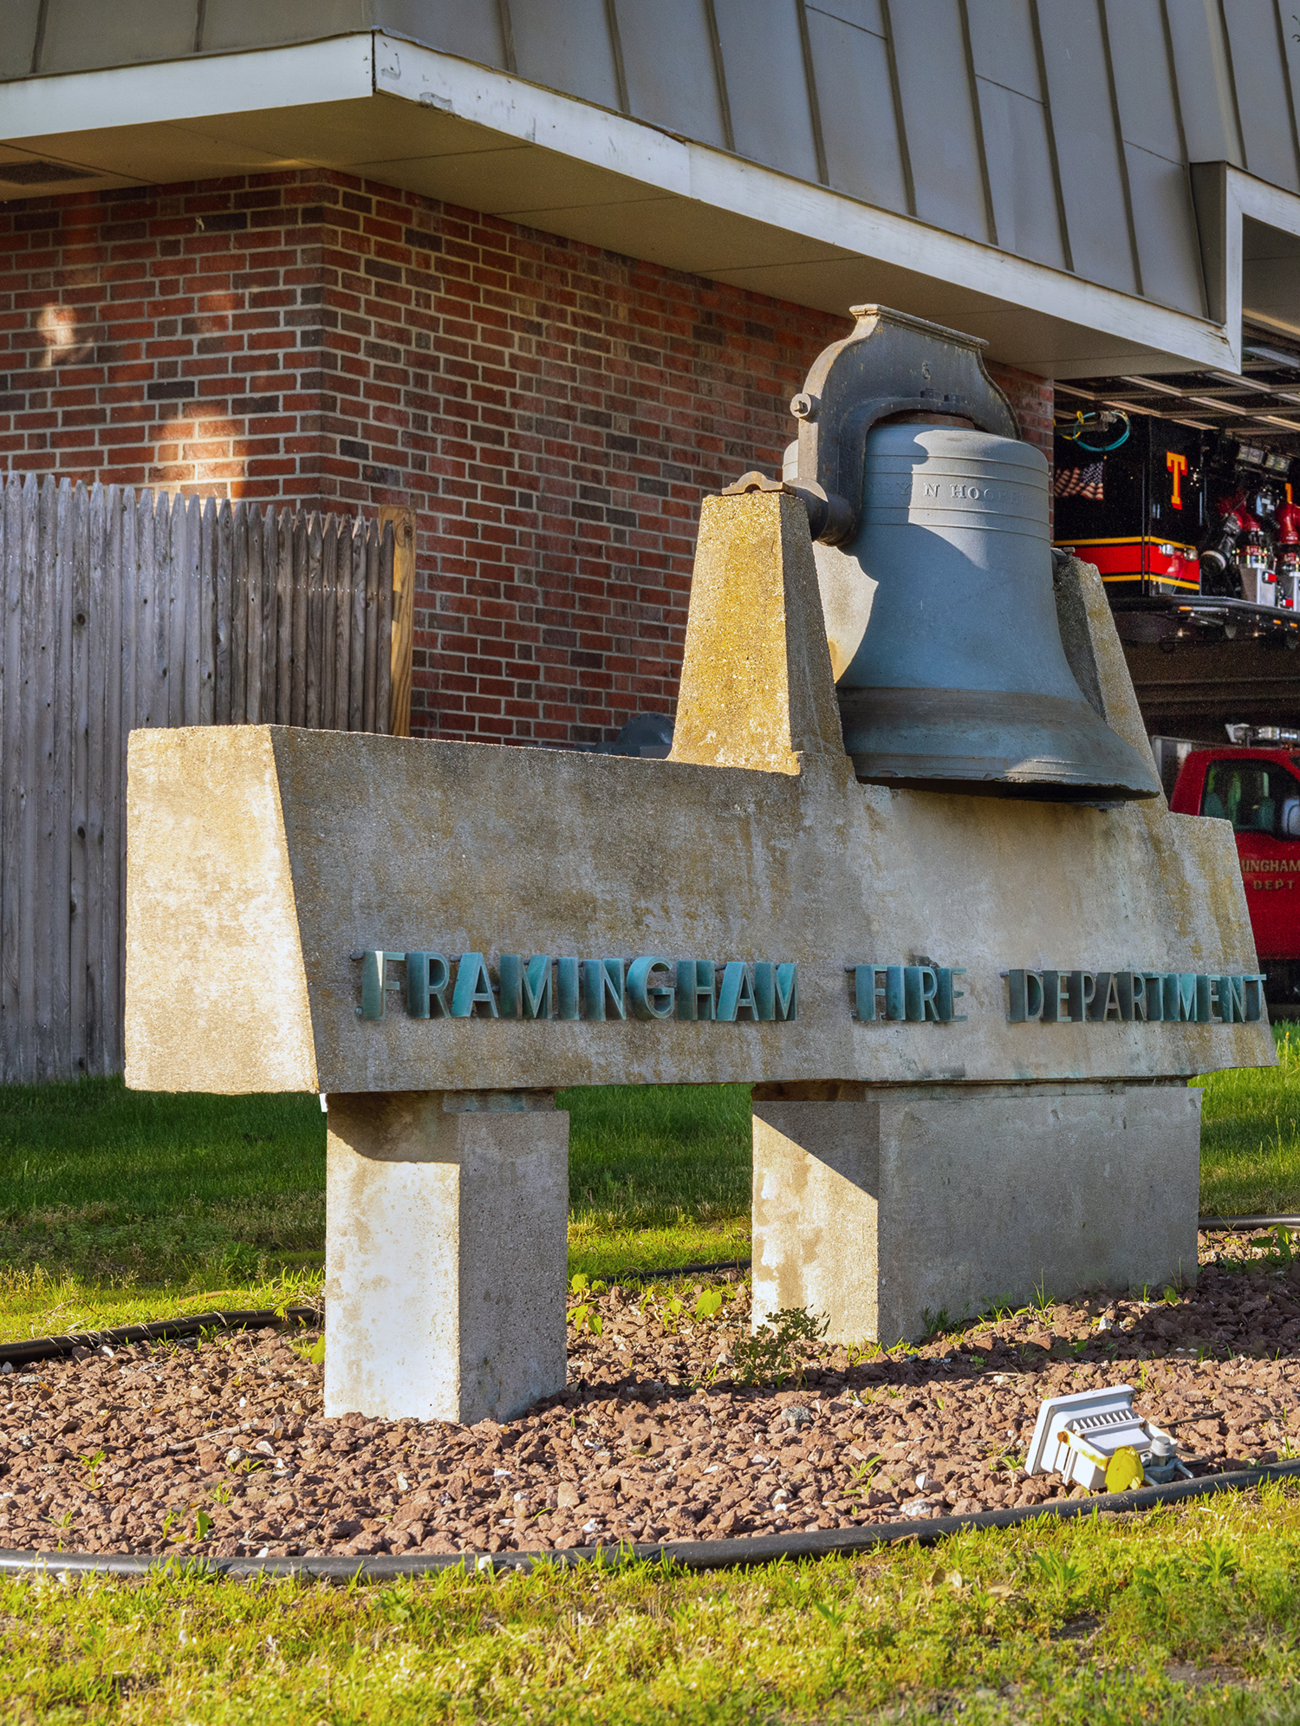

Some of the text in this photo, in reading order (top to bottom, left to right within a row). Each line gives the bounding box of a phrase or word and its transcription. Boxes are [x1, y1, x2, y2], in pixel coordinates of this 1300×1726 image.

[923, 482, 941, 498] N
[1166, 451, 1188, 510] T
[1252, 879, 1295, 890] DEPT
[361, 950, 1268, 1024] FRAMINGHAM FIRE DEPARTMENT
